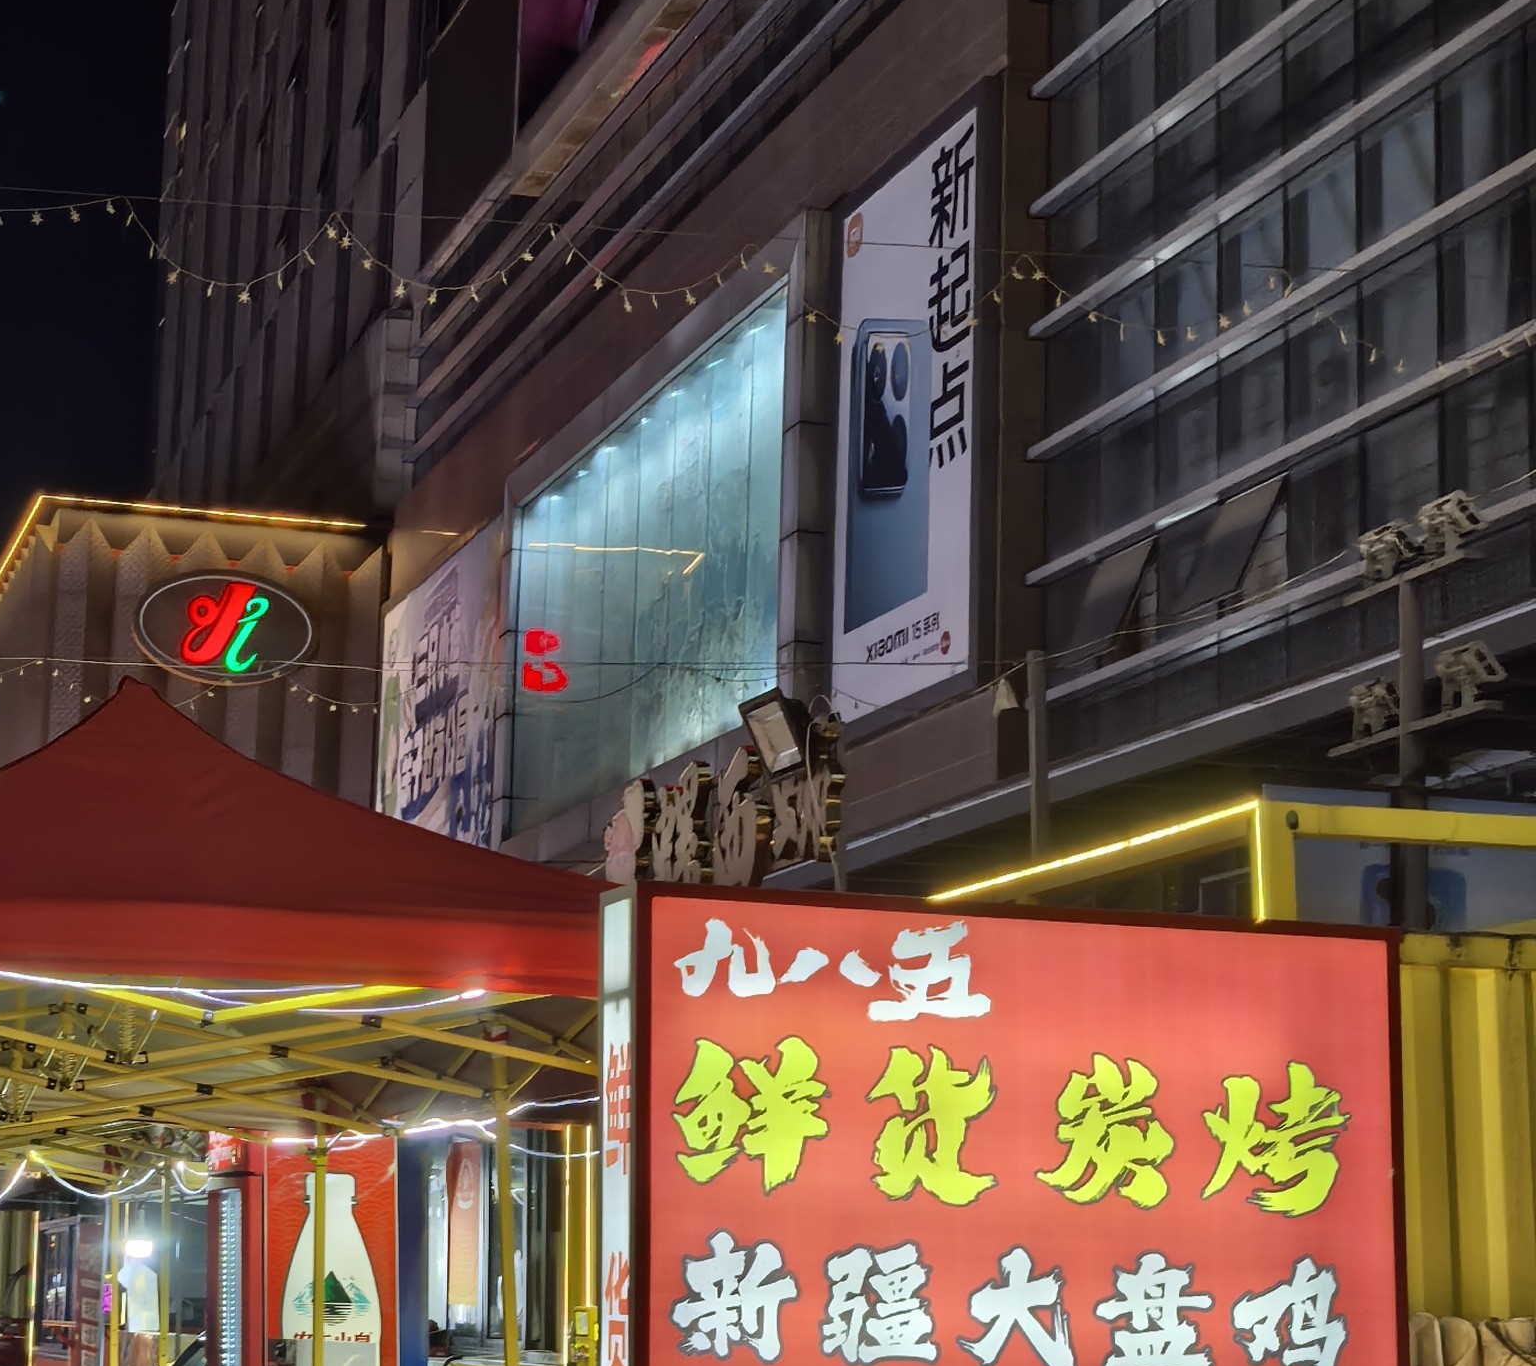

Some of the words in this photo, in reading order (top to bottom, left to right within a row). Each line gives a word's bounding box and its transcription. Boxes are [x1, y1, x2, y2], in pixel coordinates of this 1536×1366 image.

[926, 124, 975, 470] 新起点
[674, 918, 992, 1022] 九八五
[674, 1036, 1350, 1216] 鲜货炭烤
